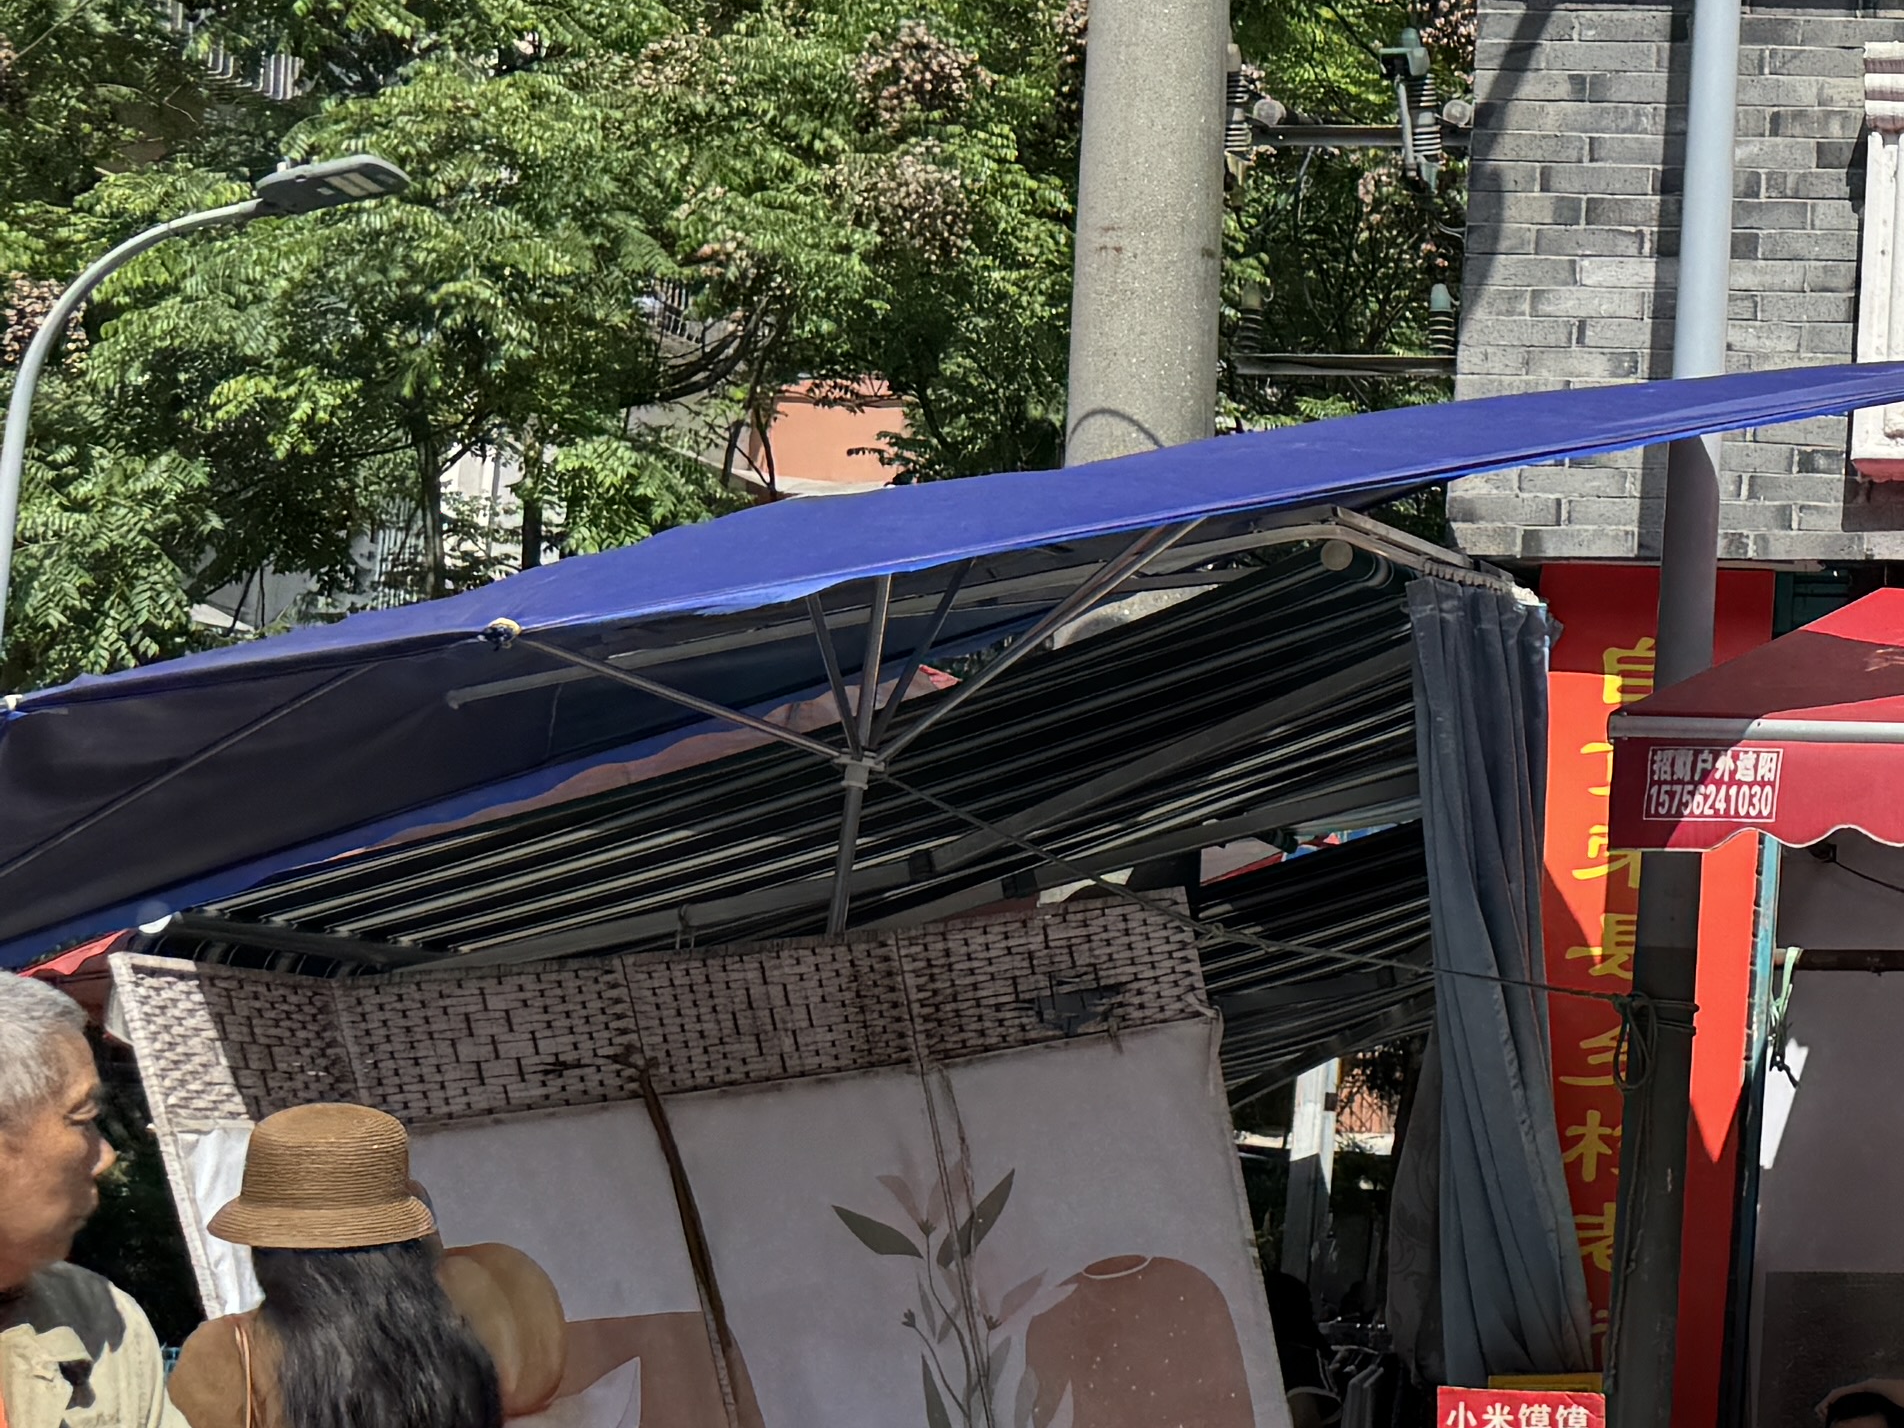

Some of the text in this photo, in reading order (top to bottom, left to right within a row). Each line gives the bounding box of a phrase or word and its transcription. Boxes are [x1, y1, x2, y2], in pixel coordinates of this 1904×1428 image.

[1653, 748, 1778, 782] 招财户外遮阳
[1650, 784, 1774, 817] 15756241030
